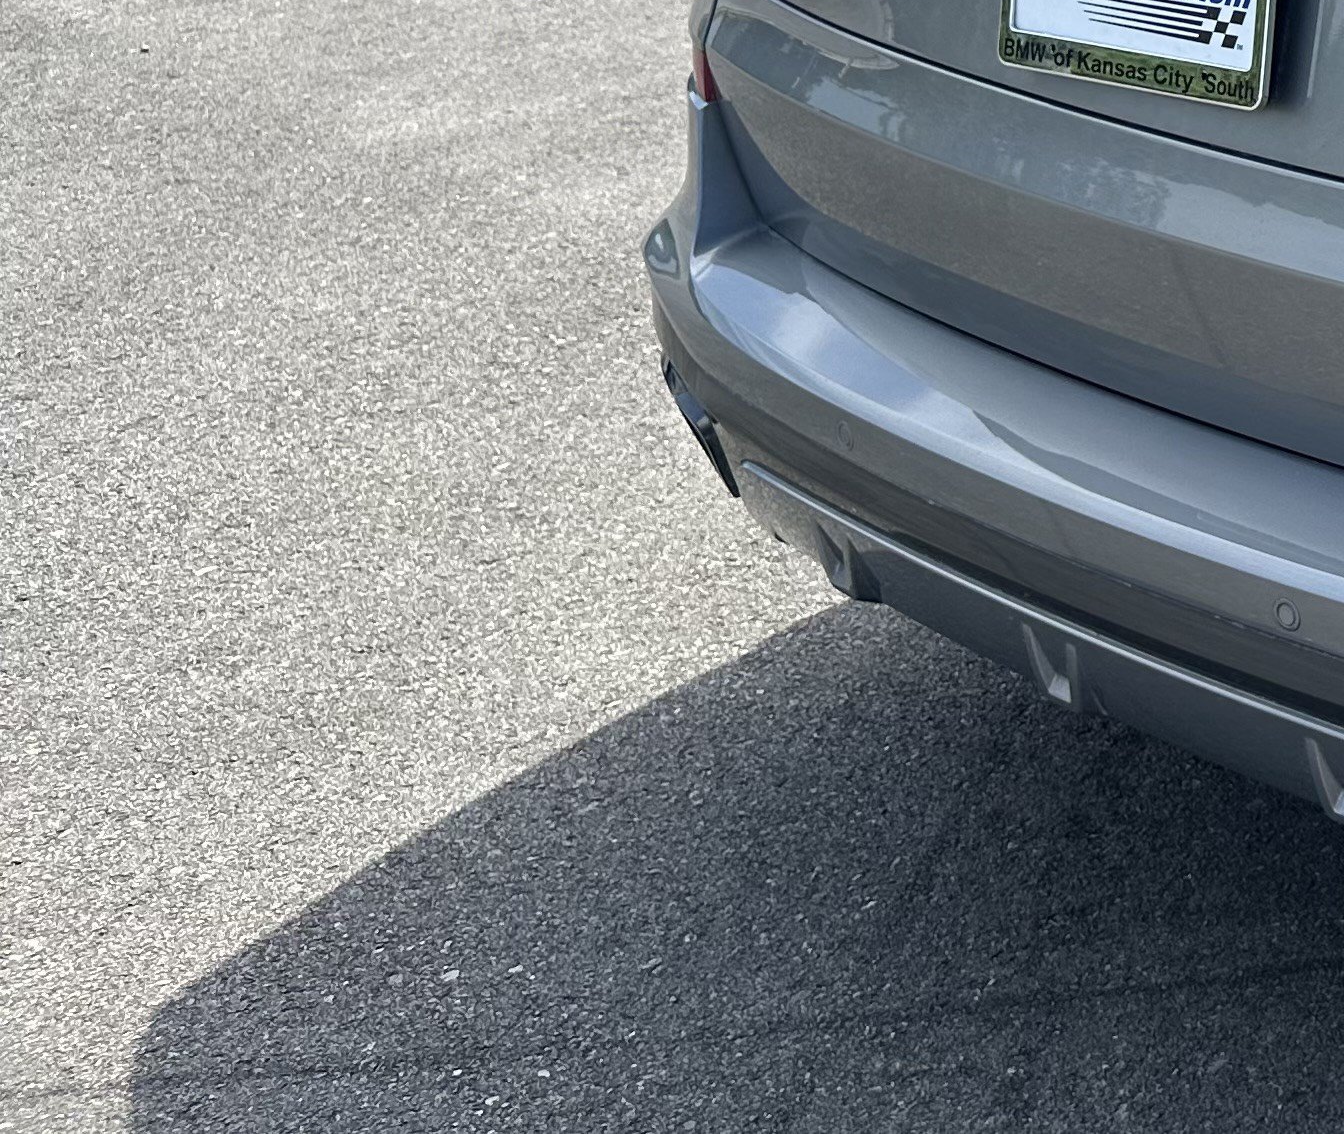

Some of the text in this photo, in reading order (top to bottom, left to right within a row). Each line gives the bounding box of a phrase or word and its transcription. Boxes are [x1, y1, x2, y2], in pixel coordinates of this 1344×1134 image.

[1003, 38, 1256, 102] BMW of Kansas City South
